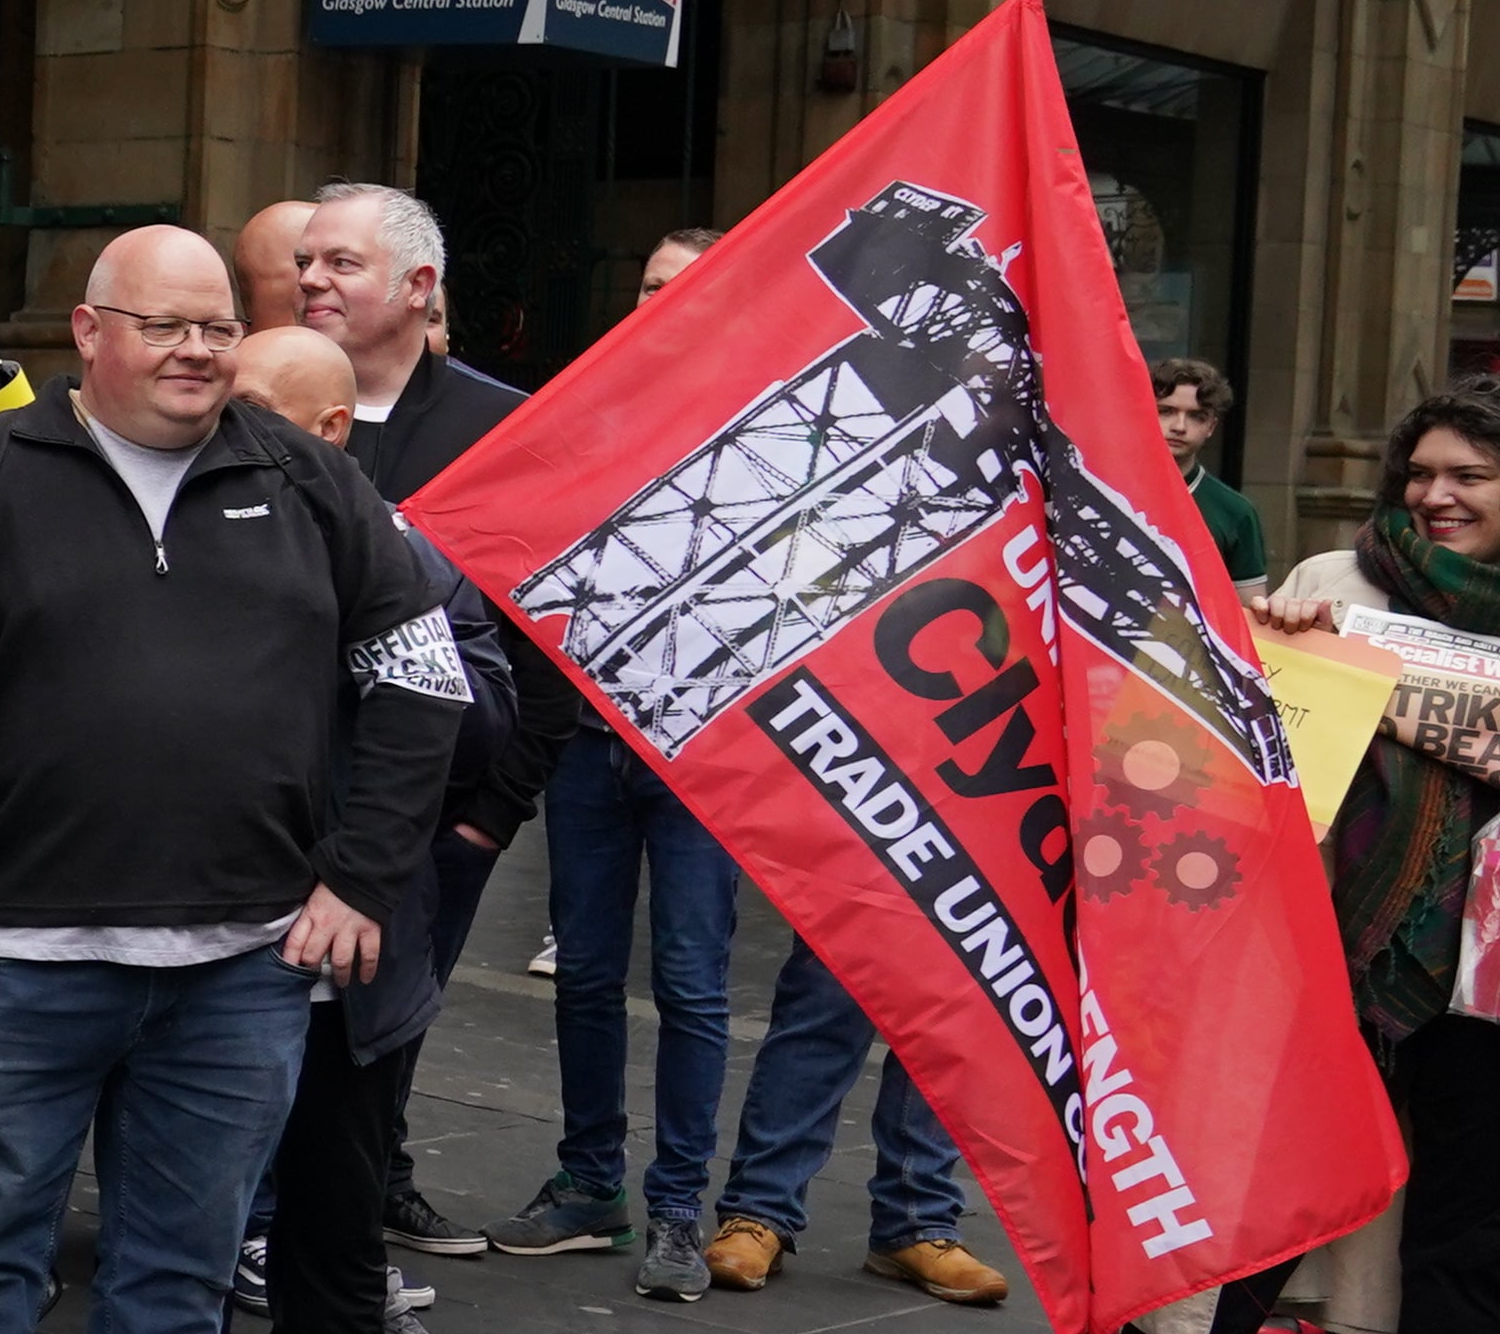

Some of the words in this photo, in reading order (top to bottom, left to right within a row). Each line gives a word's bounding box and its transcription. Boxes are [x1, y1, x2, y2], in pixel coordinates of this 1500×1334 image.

[598, 0, 633, 22] Central
[634, 5, 667, 27] Station
[1398, 674, 1441, 688] THER
[1445, 679, 1468, 692] WE
[767, 678, 957, 883] TRADE
[933, 873, 1074, 1087] UNION
